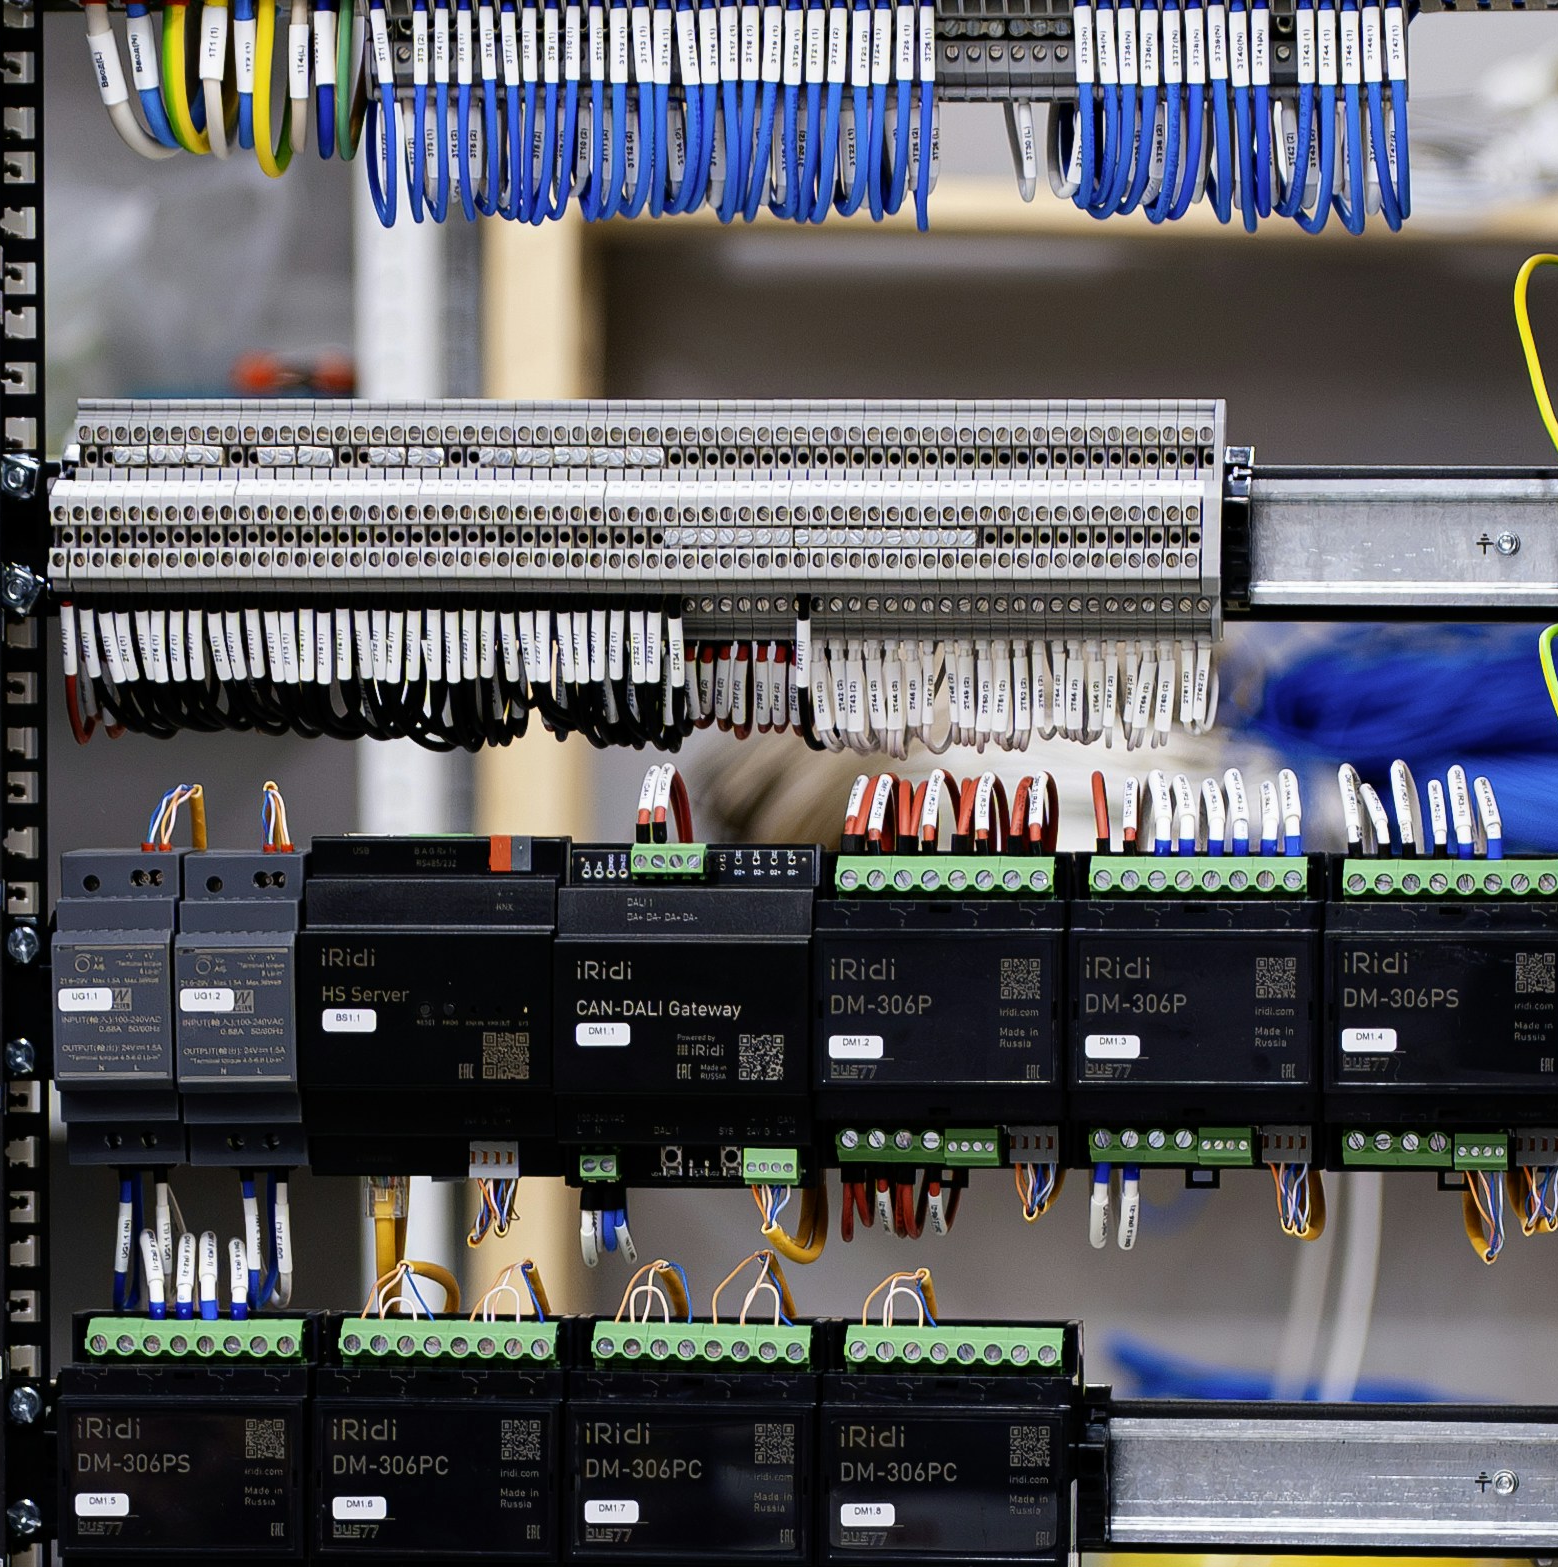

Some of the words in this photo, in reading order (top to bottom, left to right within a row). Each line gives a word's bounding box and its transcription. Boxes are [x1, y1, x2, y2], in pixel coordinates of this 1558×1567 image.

[321, 948, 375, 966] iRidi
[1344, 952, 1408, 974] iRidi
[577, 961, 632, 980] iRidi
[830, 959, 895, 980] iRidi
[1085, 957, 1150, 979] iRidi
[72, 992, 98, 1000] UG1.1
[194, 992, 220, 1000] UG1.2
[322, 987, 345, 1001] HS
[352, 987, 409, 1002] Server
[1344, 989, 1459, 1007] DM-306PS
[576, 1000, 662, 1016] CAN-DALI
[669, 1001, 741, 1020] Gateway
[831, 995, 932, 1014] DM-306P
[1086, 994, 1187, 1014] DM-306P
[336, 1013, 360, 1022] BS1.1
[588, 1027, 614, 1035] DM1.1
[1000, 1028, 1024, 1036] Made
[1100, 1037, 1126, 1045] DM1.3
[691, 1045, 724, 1056] iRidi
[78, 1417, 140, 1439] iRidi
[333, 1419, 397, 1440] iRidi
[586, 1423, 650, 1444] iRidi
[840, 1426, 905, 1447] iRidi
[78, 1454, 190, 1473] DM-306PS
[333, 1456, 449, 1474] DM-306PC
[586, 1459, 702, 1478] DM-306PC
[841, 1463, 957, 1481] DM-306PC
[89, 1497, 115, 1505] DM1.5
[346, 1500, 373, 1508] DM1.6
[854, 1507, 881, 1515] DM1.8
